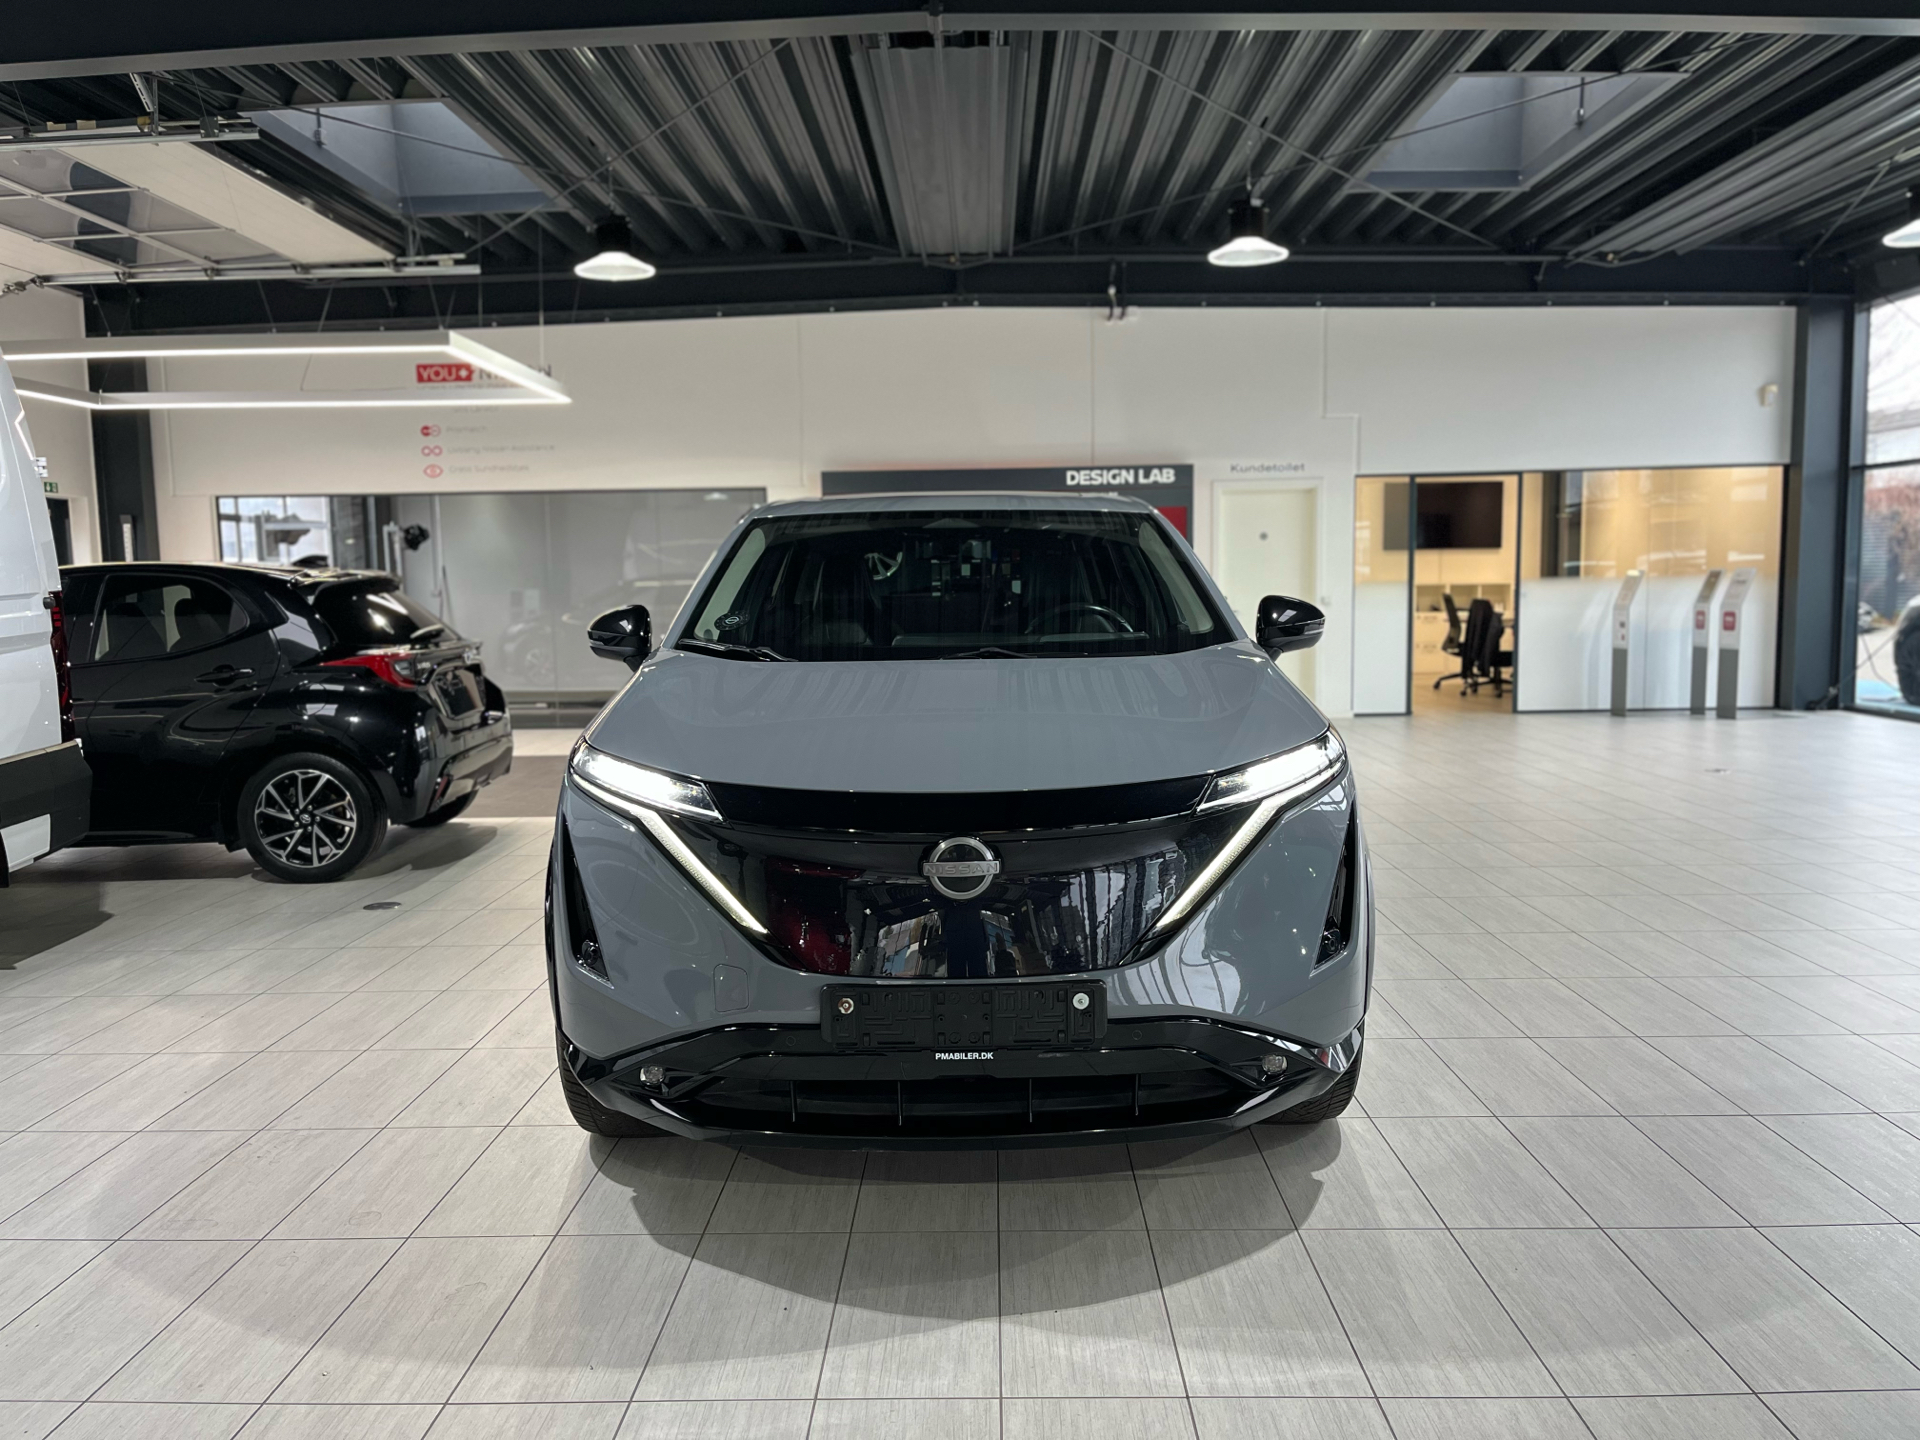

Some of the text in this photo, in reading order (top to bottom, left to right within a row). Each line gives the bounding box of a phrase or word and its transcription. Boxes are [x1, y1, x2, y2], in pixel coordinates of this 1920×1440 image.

[1066, 468, 1176, 485] DESIGN LAB
[925, 863, 998, 875] NISSAN
[935, 1052, 994, 1060] PMABILER.DK
